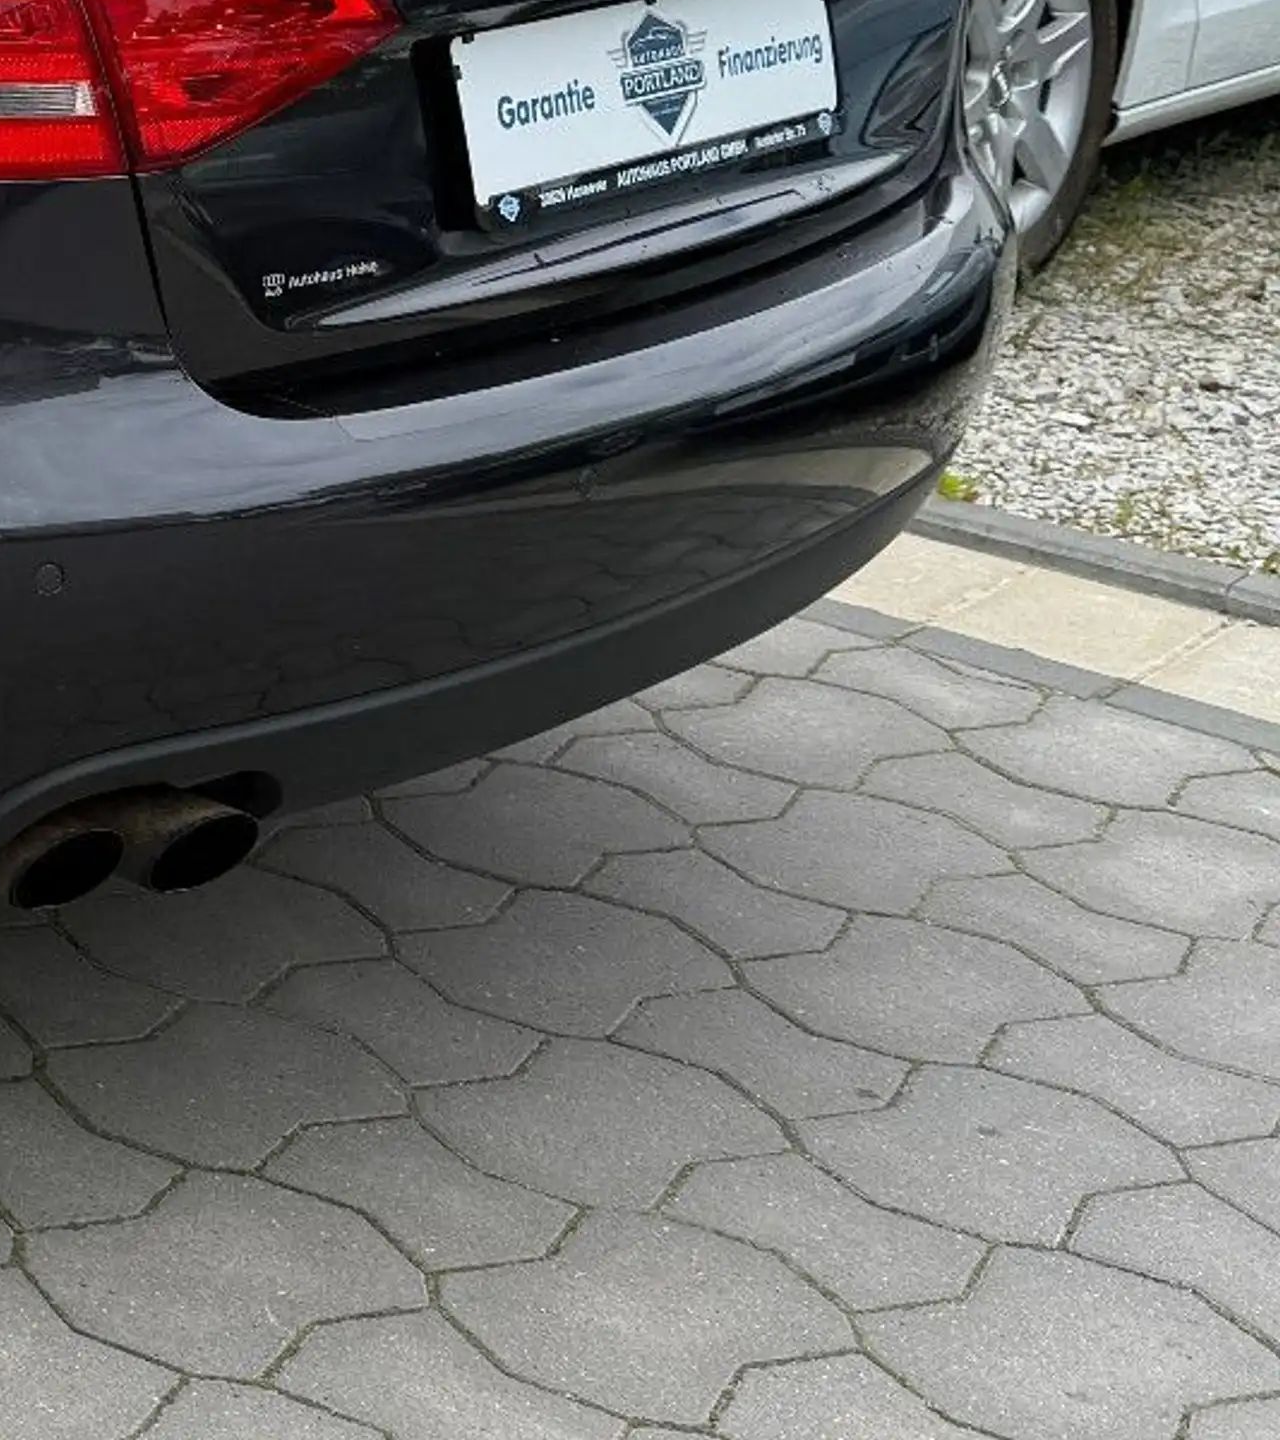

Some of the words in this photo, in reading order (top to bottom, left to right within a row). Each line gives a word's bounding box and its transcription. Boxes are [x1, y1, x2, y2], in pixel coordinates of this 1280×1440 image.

[718, 33, 824, 79] Finanzierung
[624, 65, 700, 97] PORTLAND
[497, 79, 596, 130] Garantie
